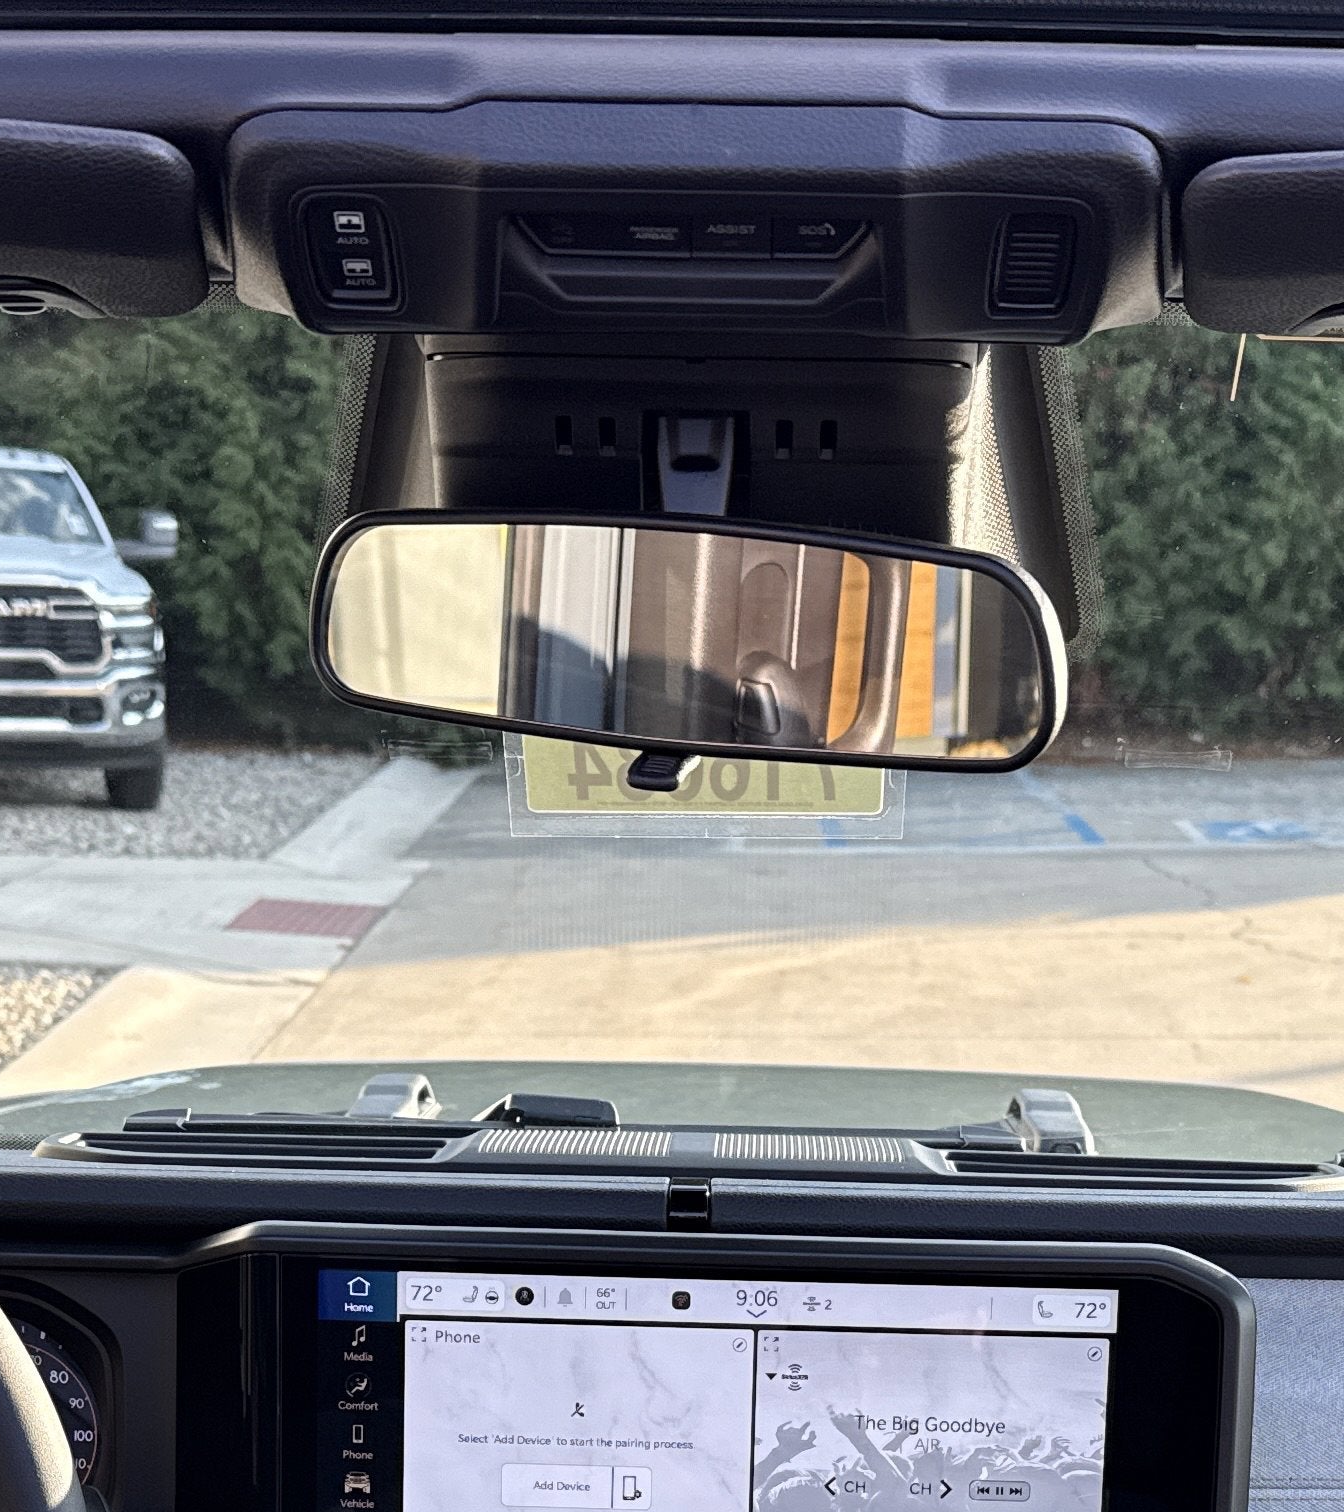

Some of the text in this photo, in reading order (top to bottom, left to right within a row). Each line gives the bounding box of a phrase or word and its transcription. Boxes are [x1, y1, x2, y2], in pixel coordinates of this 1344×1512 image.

[707, 225, 755, 235] ASSIST
[799, 225, 826, 235] SOS
[337, 237, 369, 245] AUTO
[346, 278, 376, 286] AUTO
[736, 1289, 778, 1307] 9:06
[344, 1302, 374, 1313] Home
[596, 1301, 617, 1310] OUT
[824, 1299, 832, 1311] 2
[435, 1329, 481, 1345] Phone
[344, 1351, 373, 1362] Media
[49, 1370, 69, 1384] 80
[69, 1397, 85, 1409] 90
[338, 1400, 378, 1412] Comfort
[855, 1414, 1006, 1437] The Big Goodbye
[74, 1429, 94, 1442] 100
[457, 1433, 489, 1445] Select
[556, 1436, 568, 1447] to
[570, 1437, 595, 1448] start
[596, 1437, 613, 1449] the
[615, 1437, 652, 1451] pairing
[343, 1449, 373, 1460] Phone
[533, 1480, 591, 1492] Add Device
[844, 1481, 866, 1493] CH
[910, 1483, 932, 1496] CH
[340, 1497, 375, 1509] Vehicle
